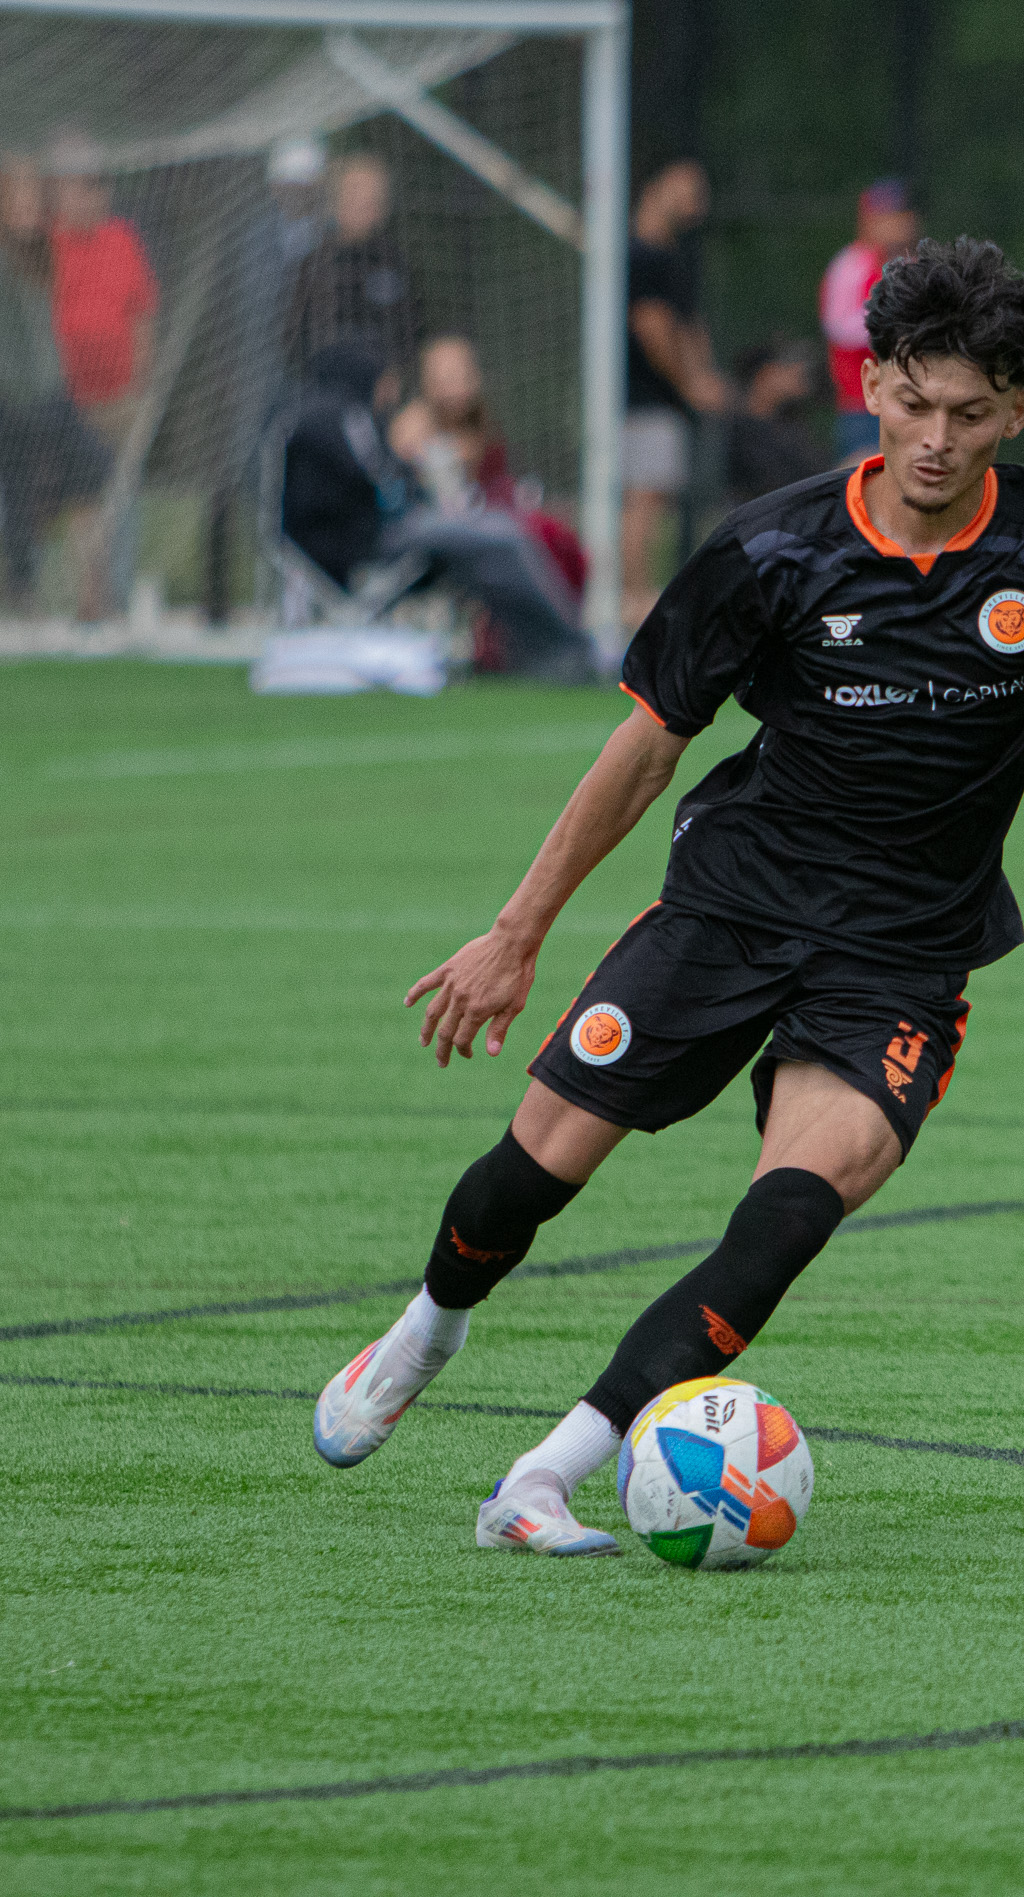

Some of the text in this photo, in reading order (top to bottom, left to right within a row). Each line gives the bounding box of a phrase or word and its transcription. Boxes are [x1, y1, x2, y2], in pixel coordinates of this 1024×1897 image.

[982, 593, 1024, 619] ASHEVILLE
[822, 638, 864, 647] DIAZA
[703, 1395, 721, 1434] Voit
